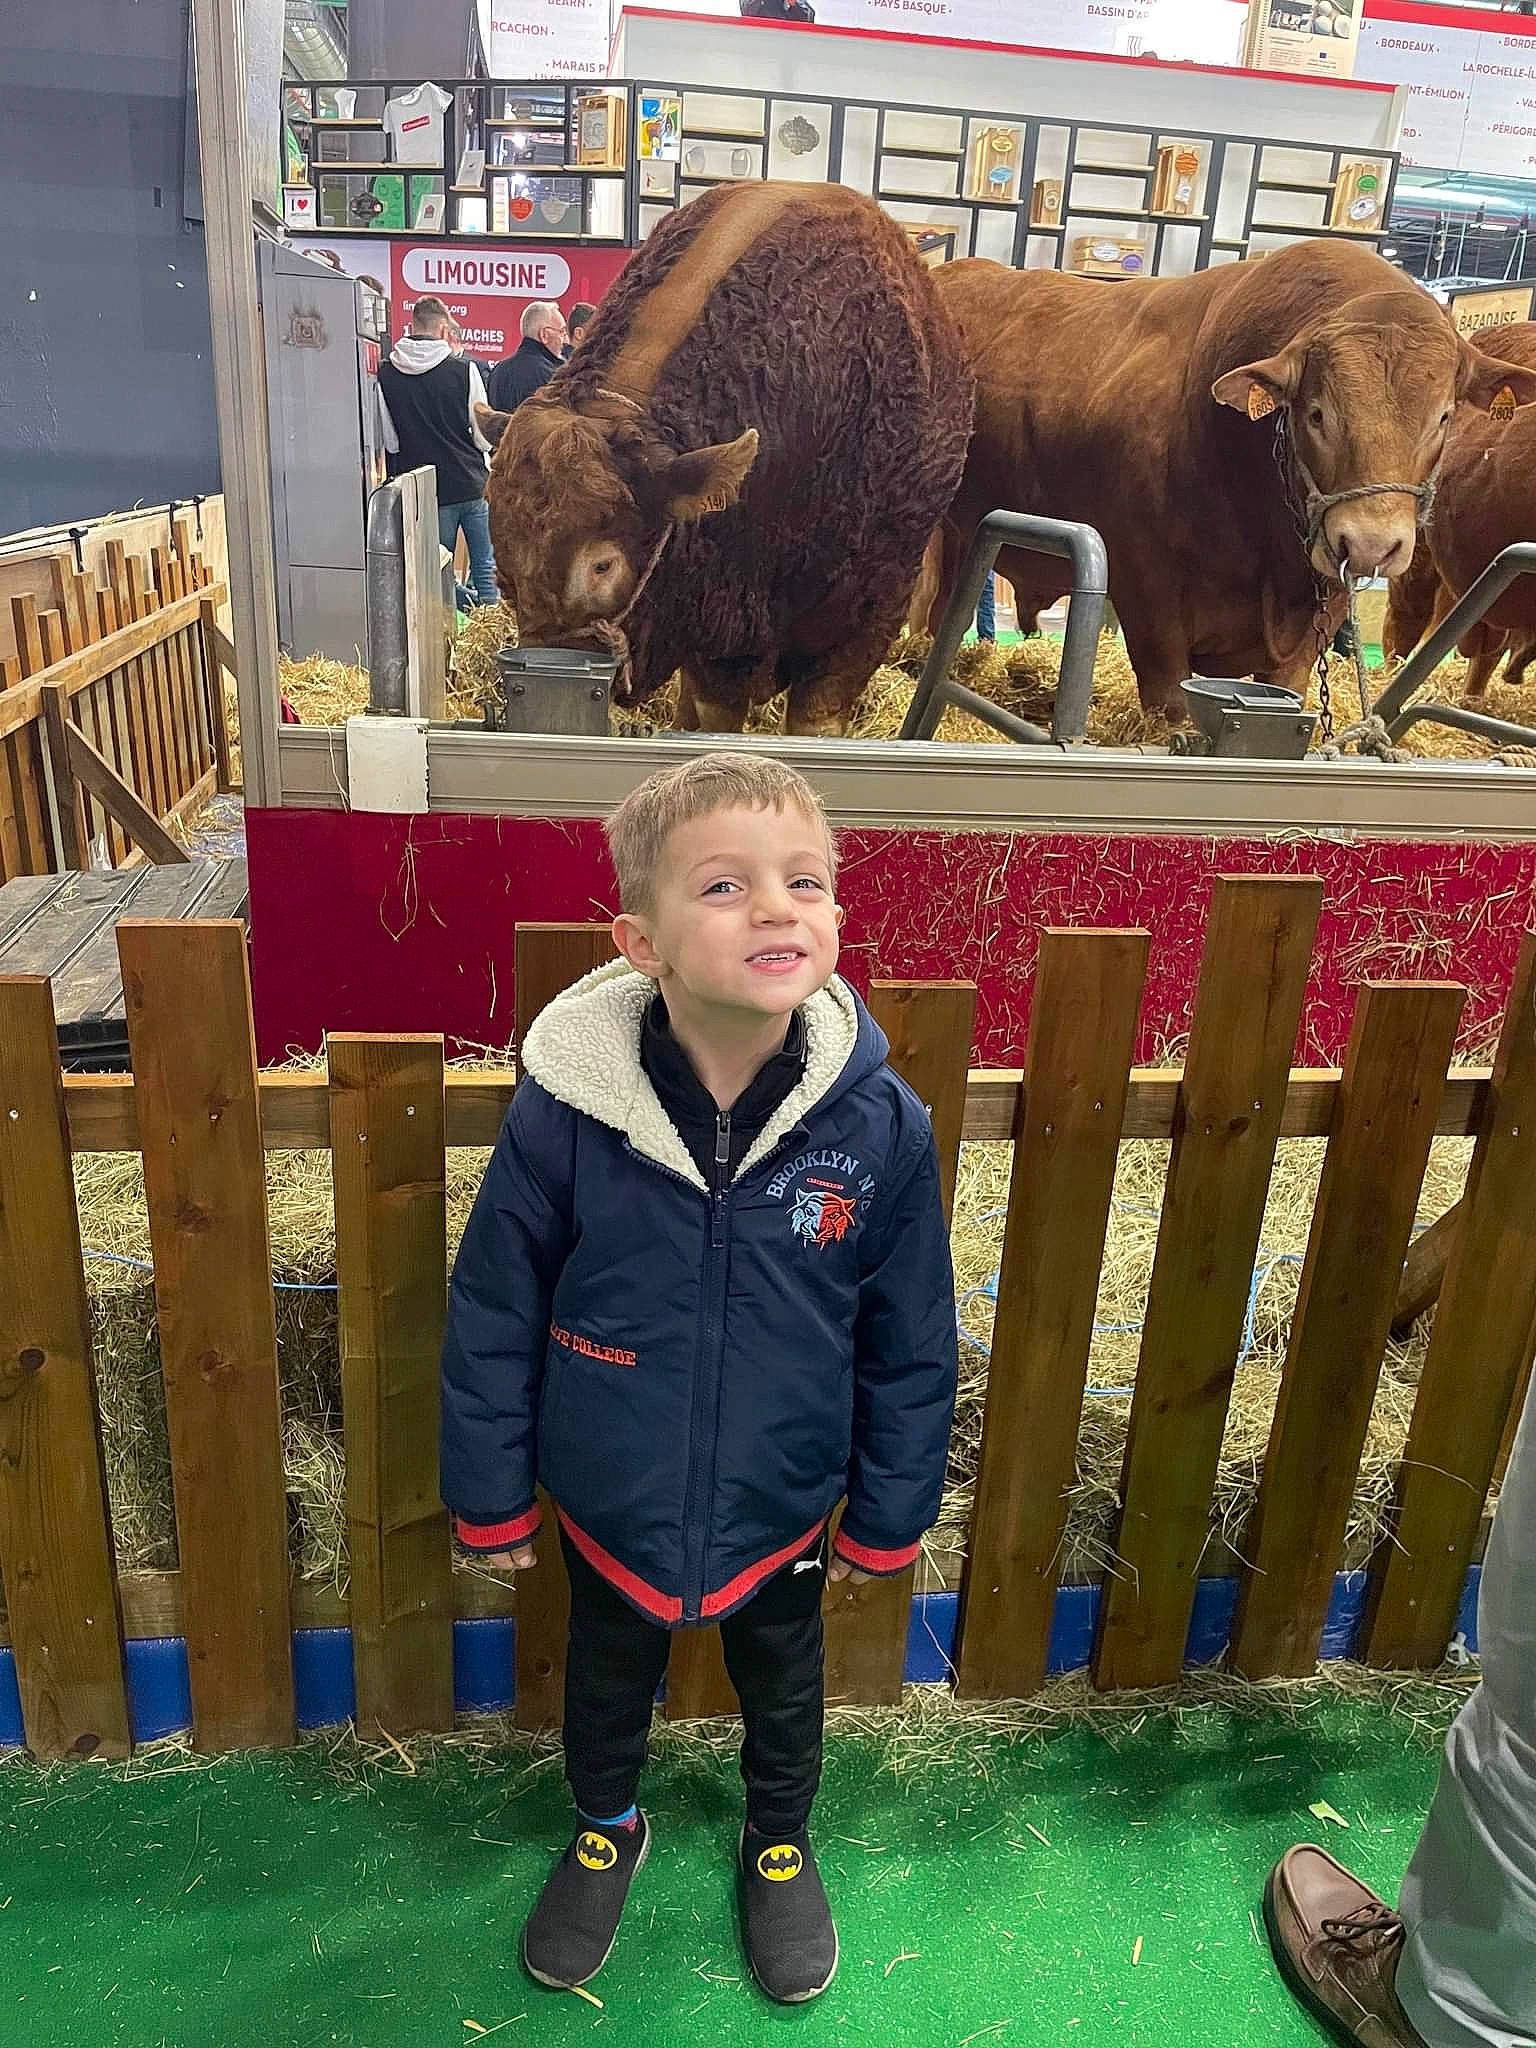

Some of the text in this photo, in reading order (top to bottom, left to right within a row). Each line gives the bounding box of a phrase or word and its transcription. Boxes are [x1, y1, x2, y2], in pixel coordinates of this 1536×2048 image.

[902, 1, 947, 15] BASQUE
[1088, 5, 1125, 17] BASSIN
[1381, 38, 1434, 53] BORDEAUX
[552, 60, 596, 73] MARAIS
[424, 260, 546, 289] LIMOUSINE
[766, 1149, 860, 1199] BROOKLYN
